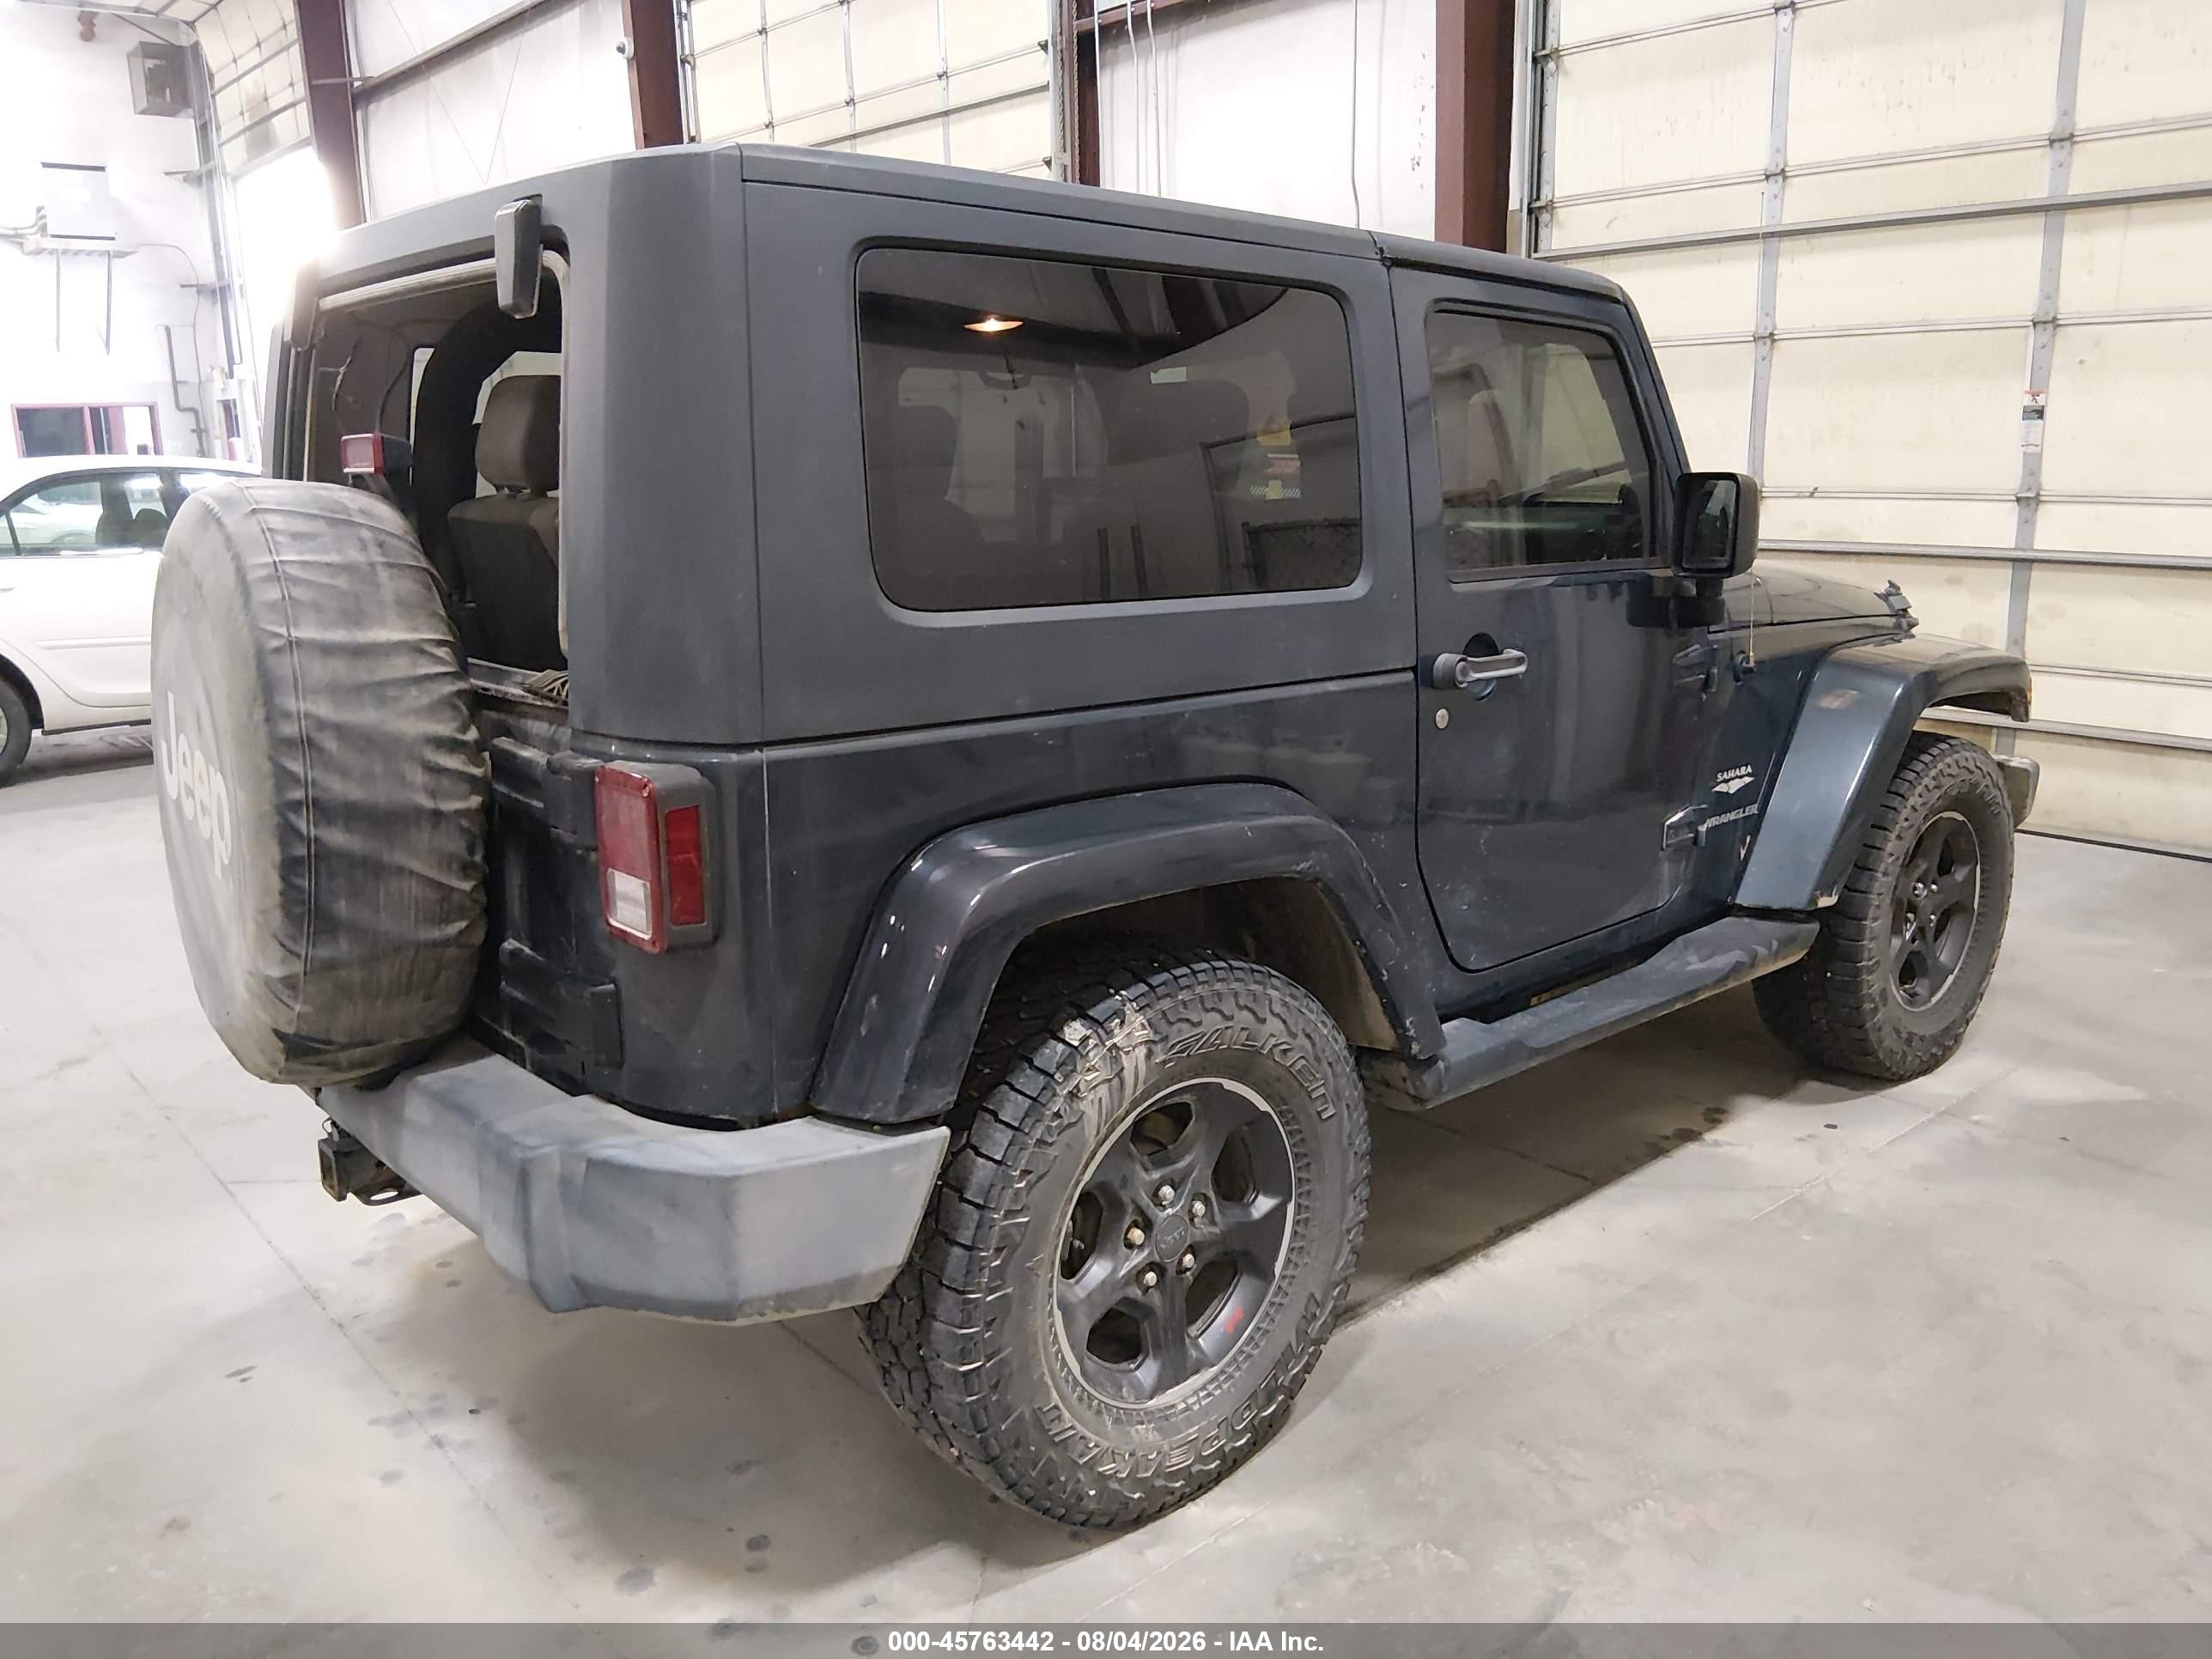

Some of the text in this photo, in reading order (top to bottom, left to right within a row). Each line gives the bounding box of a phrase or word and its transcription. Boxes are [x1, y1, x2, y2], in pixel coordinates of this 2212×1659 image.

[161, 690, 232, 879] Jeep
[1717, 764, 1753, 782] SAHARA
[1705, 803, 1759, 830] WRANGLER
[1155, 1024, 1336, 1120] FALKEN
